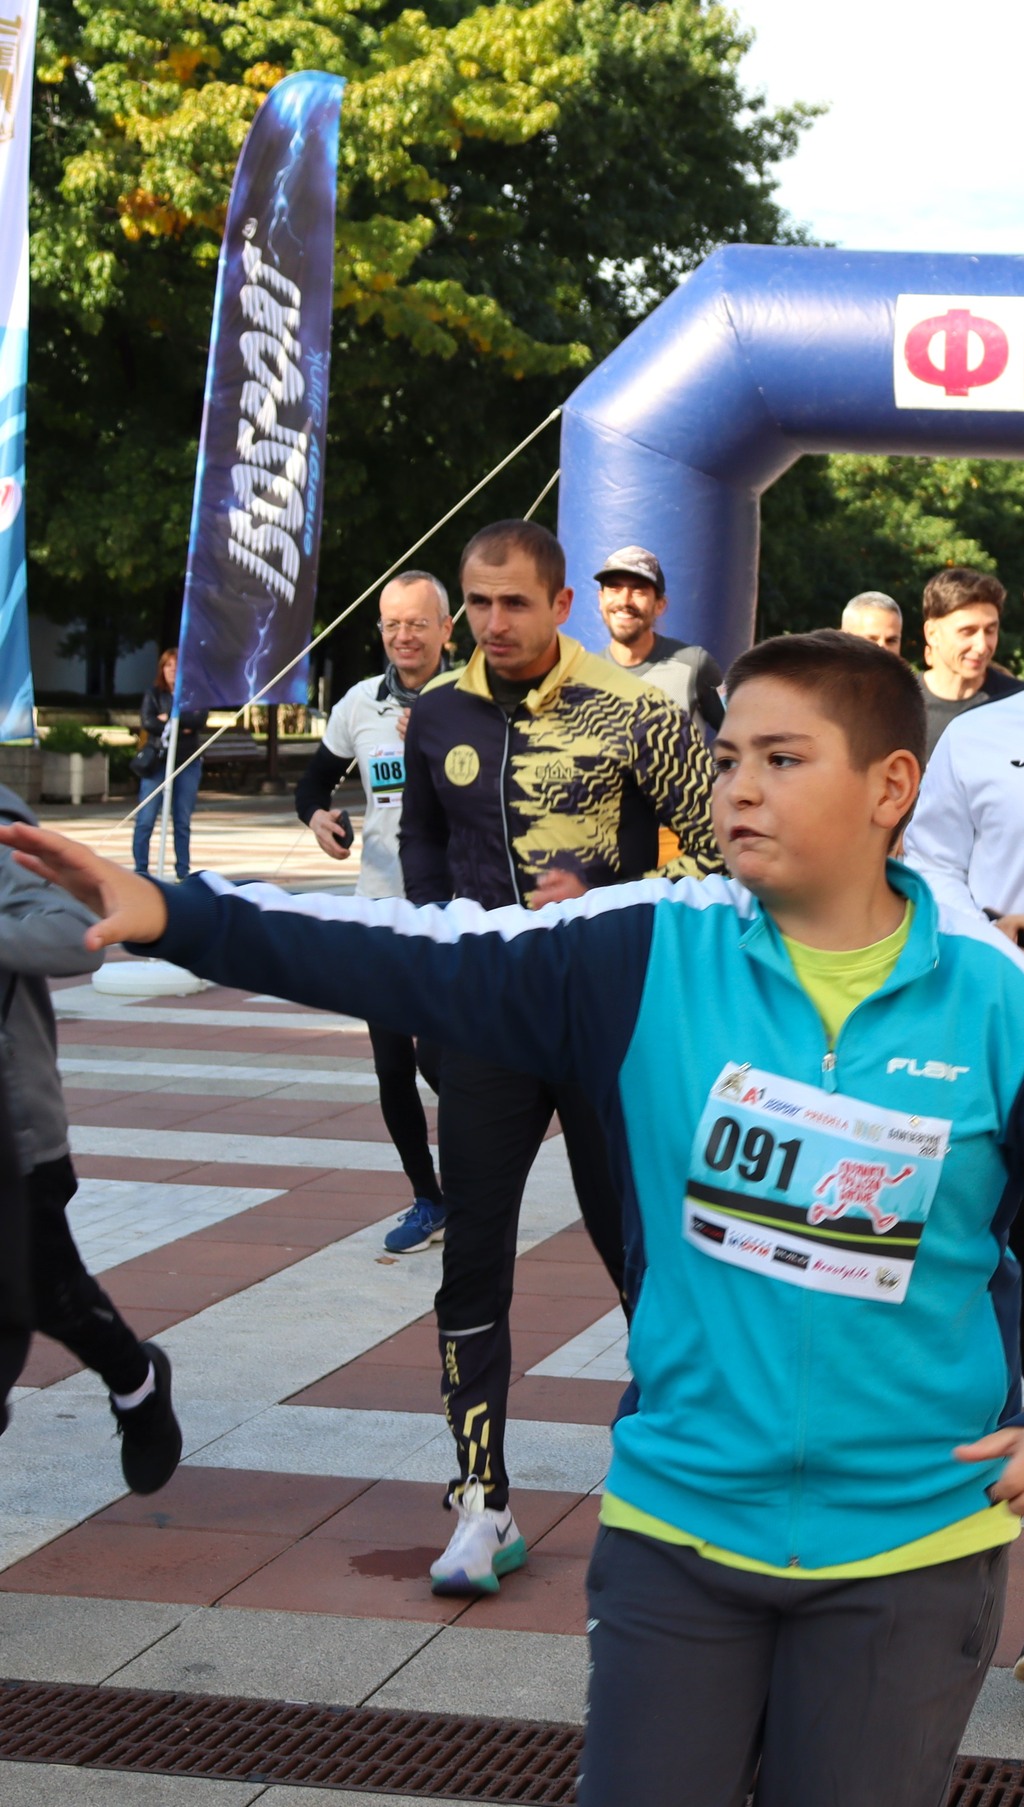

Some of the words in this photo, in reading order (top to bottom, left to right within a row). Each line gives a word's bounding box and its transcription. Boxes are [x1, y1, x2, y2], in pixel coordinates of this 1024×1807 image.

[227, 239, 308, 607] ISOSPORT
[304, 347, 325, 428] drink
[303, 433, 321, 557] energy
[372, 761, 402, 781] 108
[740, 1087, 767, 1105] A1
[704, 1116, 804, 1193] 091
